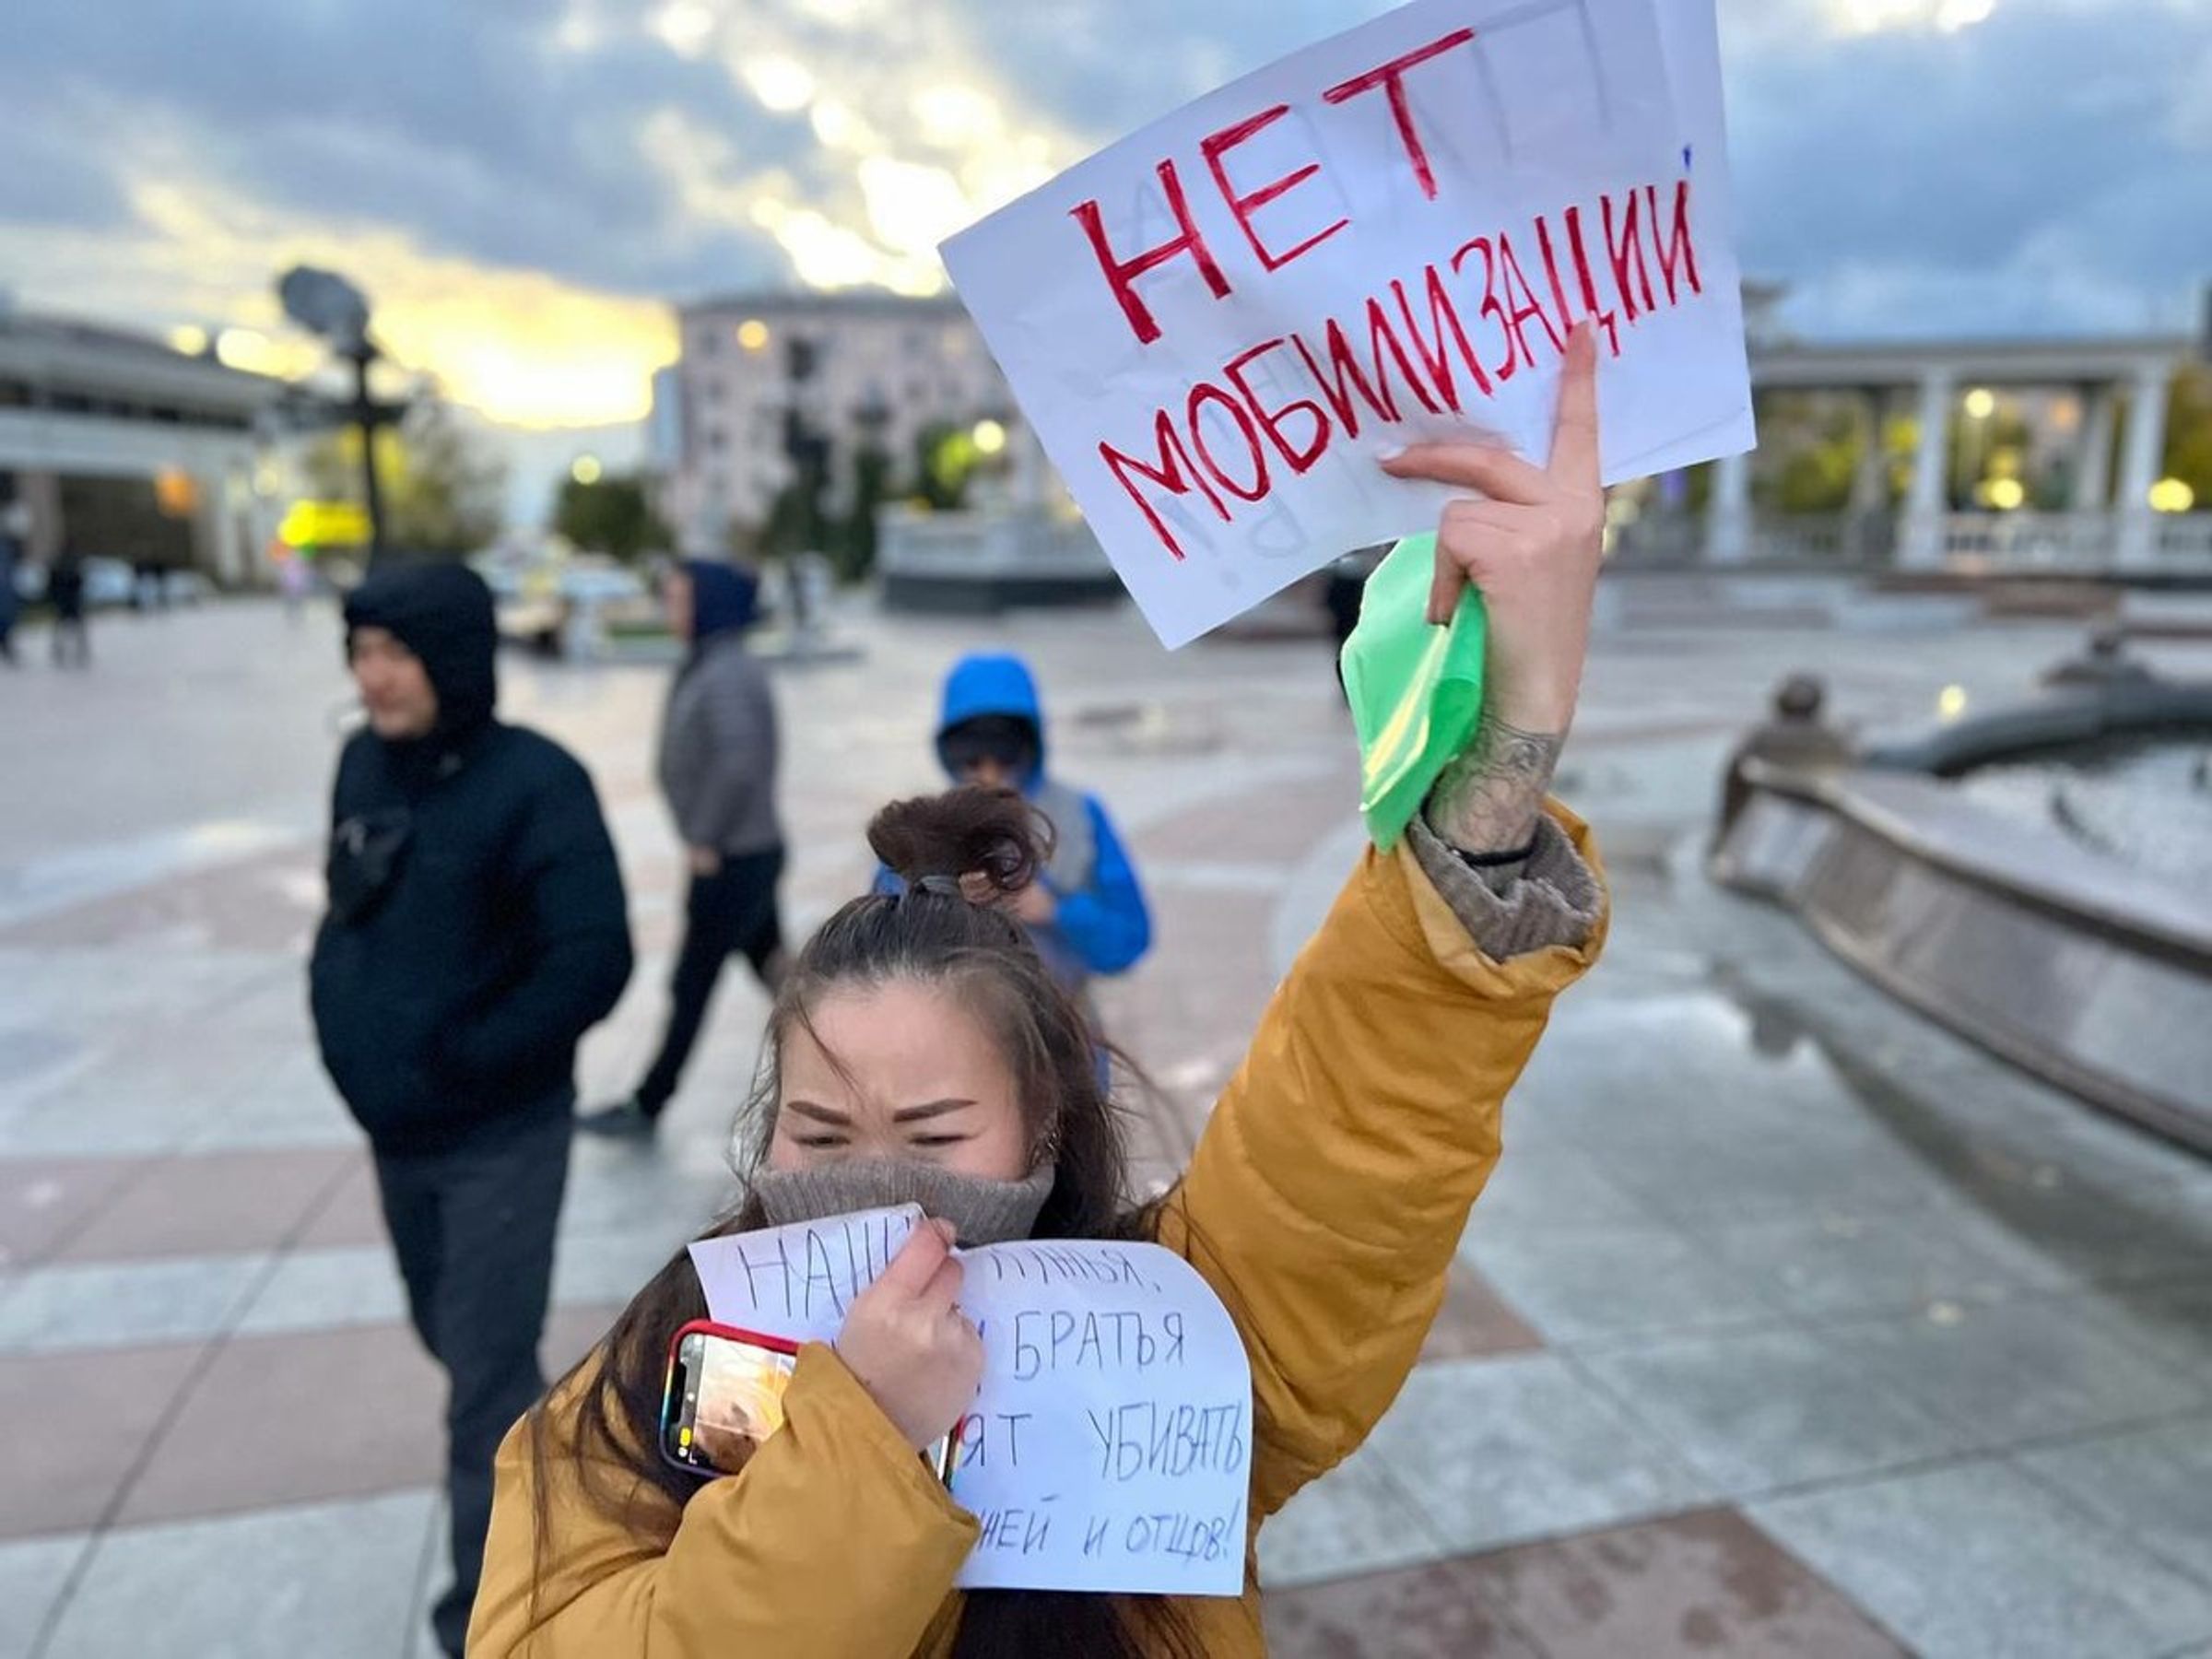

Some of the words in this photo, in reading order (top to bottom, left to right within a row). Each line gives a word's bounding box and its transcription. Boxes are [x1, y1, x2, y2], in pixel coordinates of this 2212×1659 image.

[1072, 28, 1473, 344] НЕТ
[1100, 181, 1702, 560] МОБИЛИЗАЦИИ
[736, 1215, 912, 1320] НАШ
[1014, 1310, 1185, 1381] БРАТЬЯ
[1088, 1400, 1244, 1482] УБИВАТЬ
[1083, 1515, 1110, 1557] И
[1125, 1497, 1241, 1561] ОТЦОВ!
